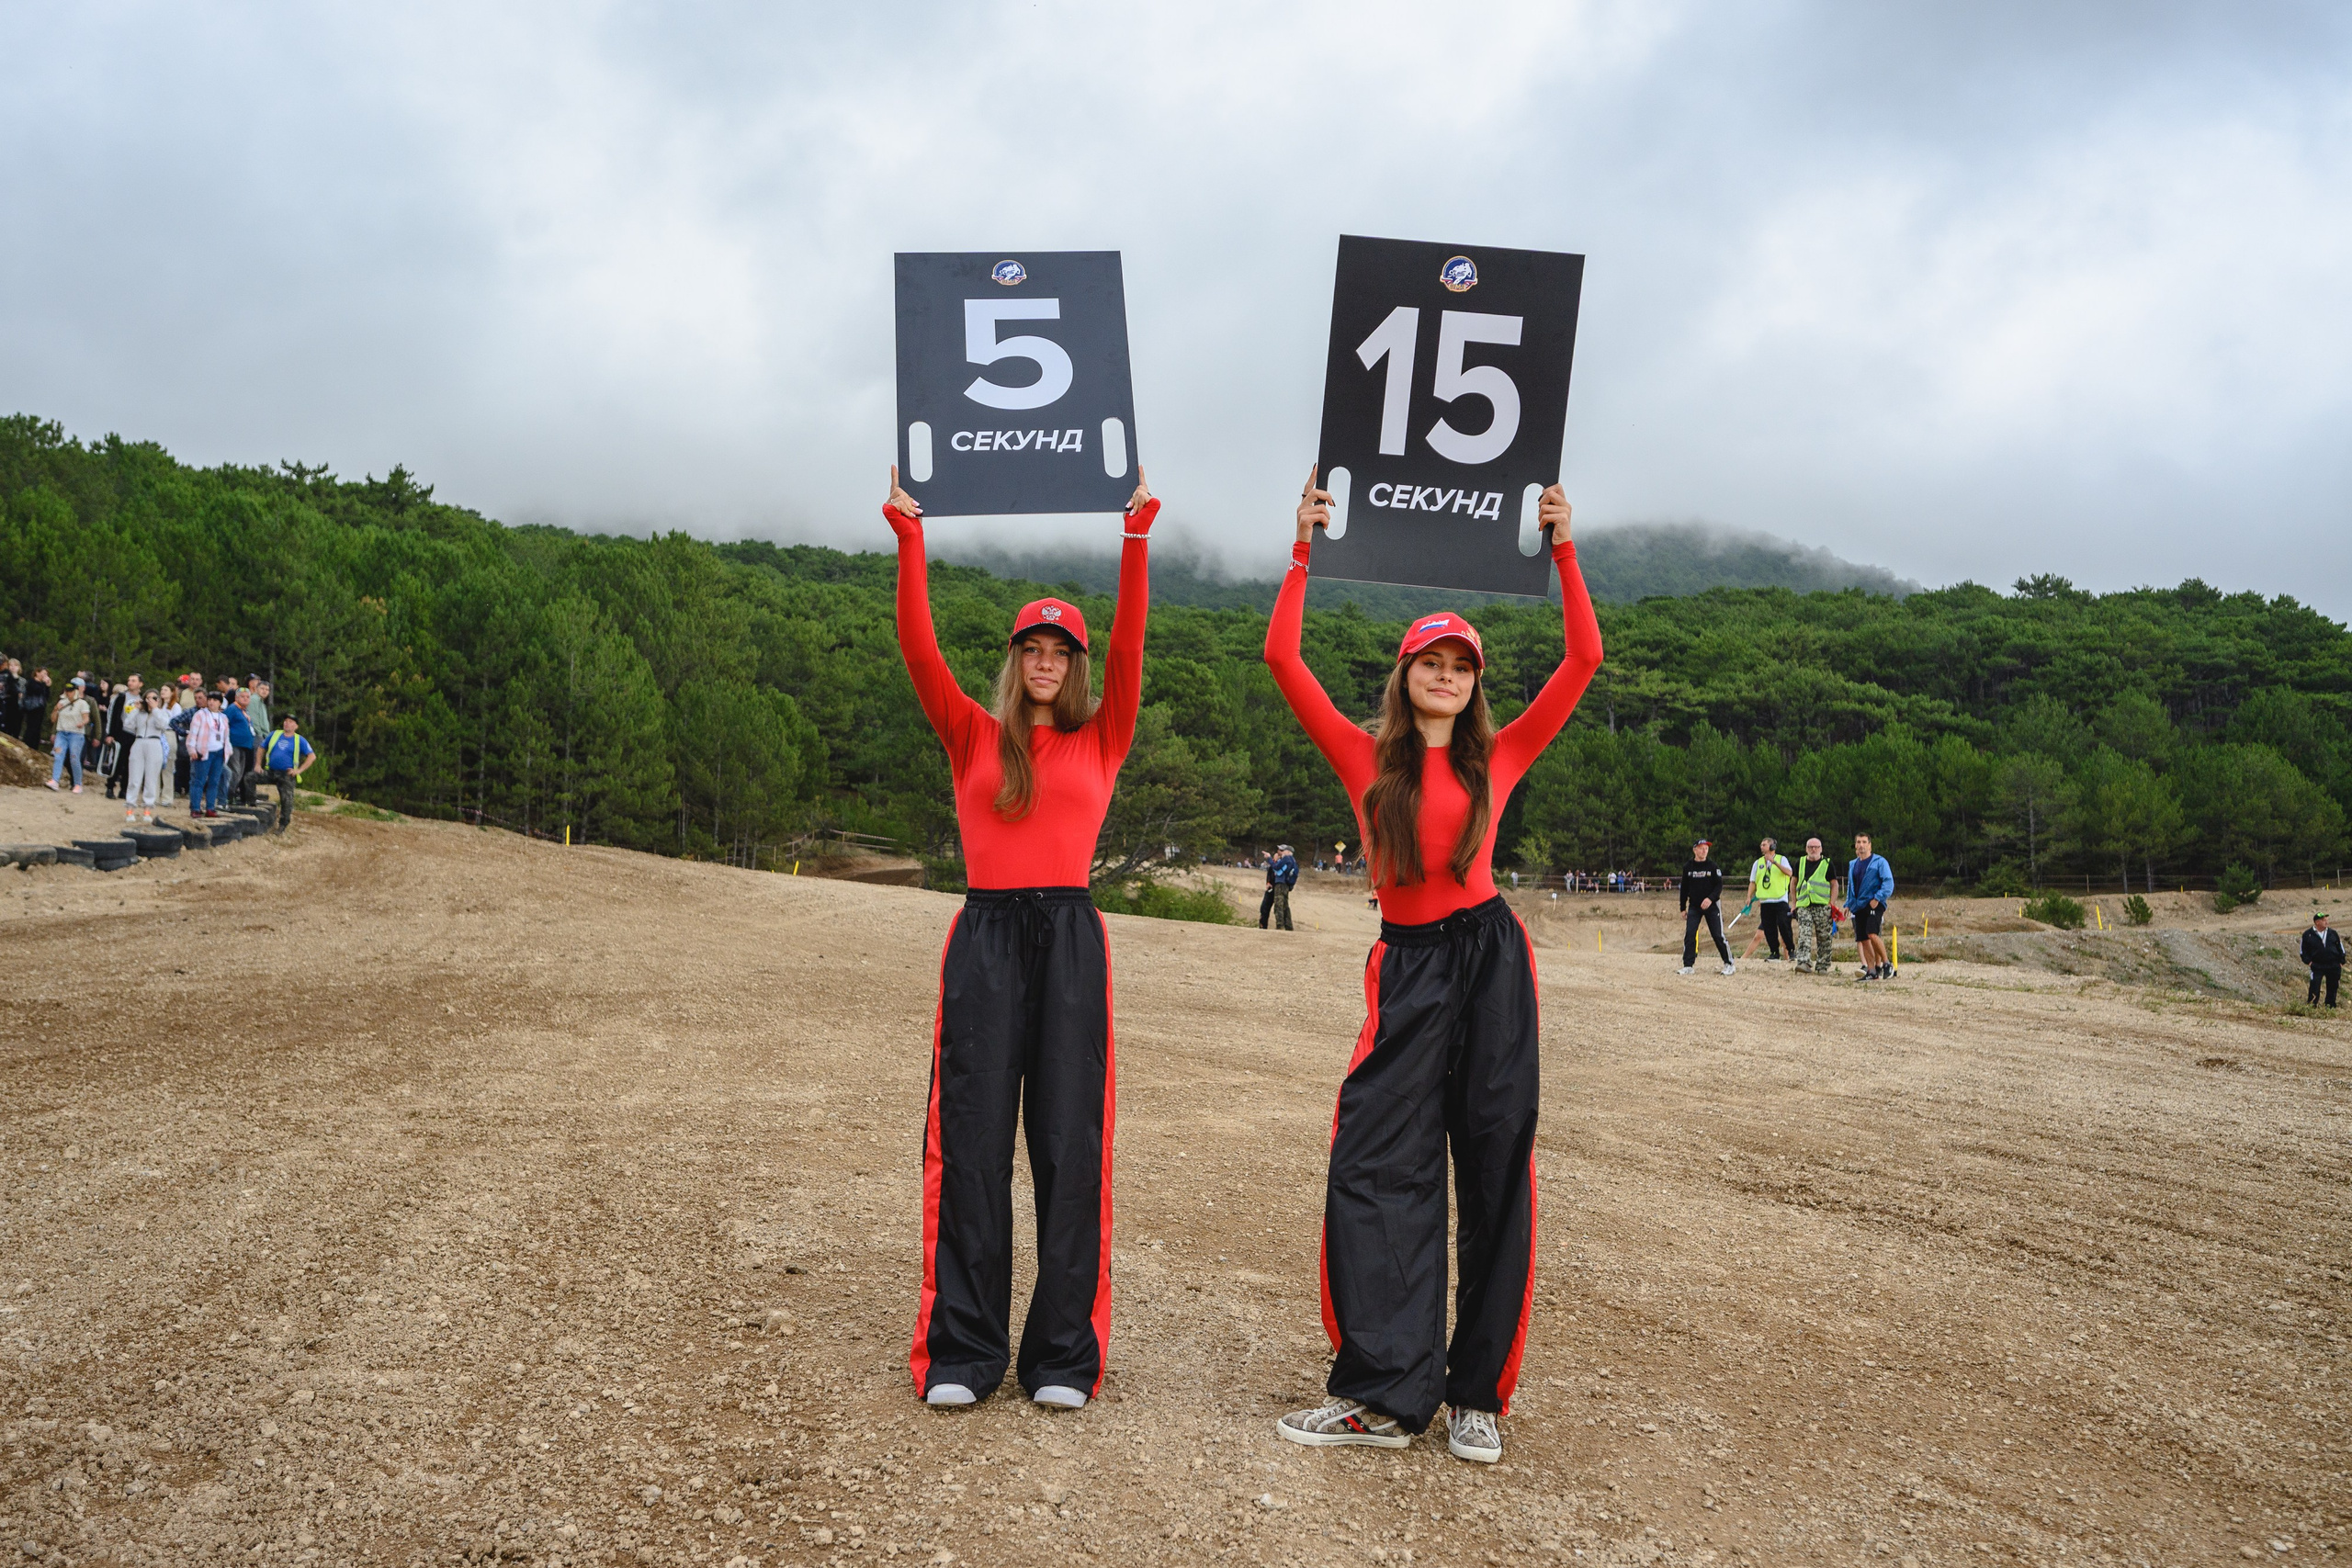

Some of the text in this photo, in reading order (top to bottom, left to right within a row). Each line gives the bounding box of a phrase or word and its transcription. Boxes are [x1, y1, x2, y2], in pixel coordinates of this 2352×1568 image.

[963, 298, 1074, 411] 5
[1356, 306, 1524, 465] 15
[950, 429, 1084, 454] СЕКУНД
[1368, 482, 1505, 522] СЕКУНД
